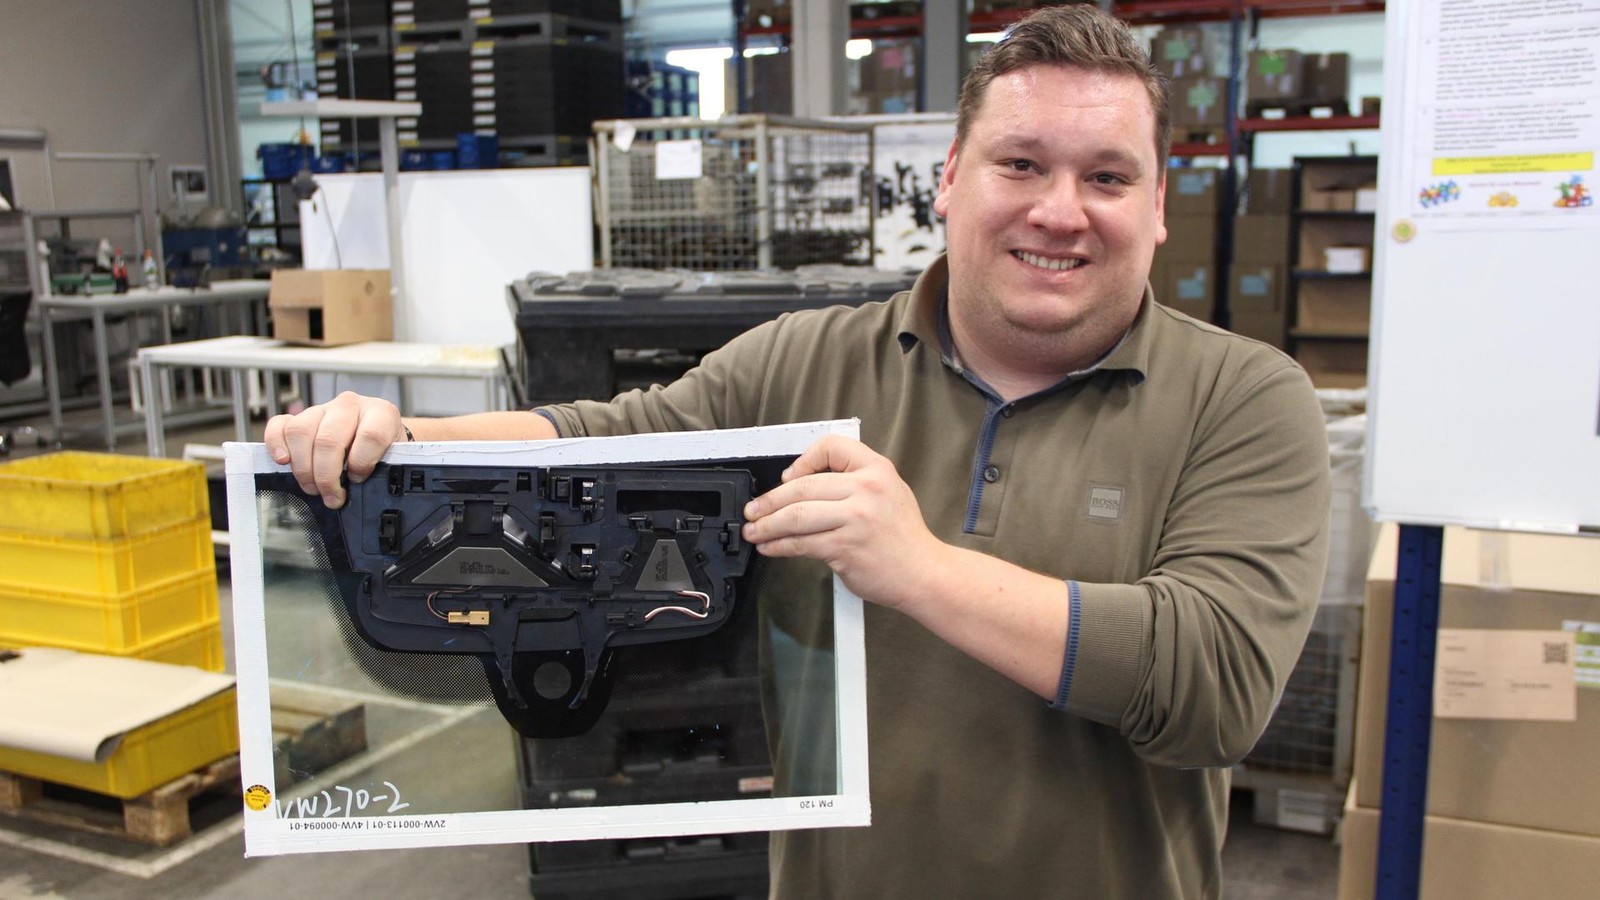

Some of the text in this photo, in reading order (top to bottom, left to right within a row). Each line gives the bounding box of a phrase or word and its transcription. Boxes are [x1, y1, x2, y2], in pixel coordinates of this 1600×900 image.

[1092, 497, 1119, 506] BOSS
[800, 800, 834, 809] PM 120
[290, 821, 363, 830] 4VW-000094-01
[372, 820, 446, 829] 2VW-000113-01
